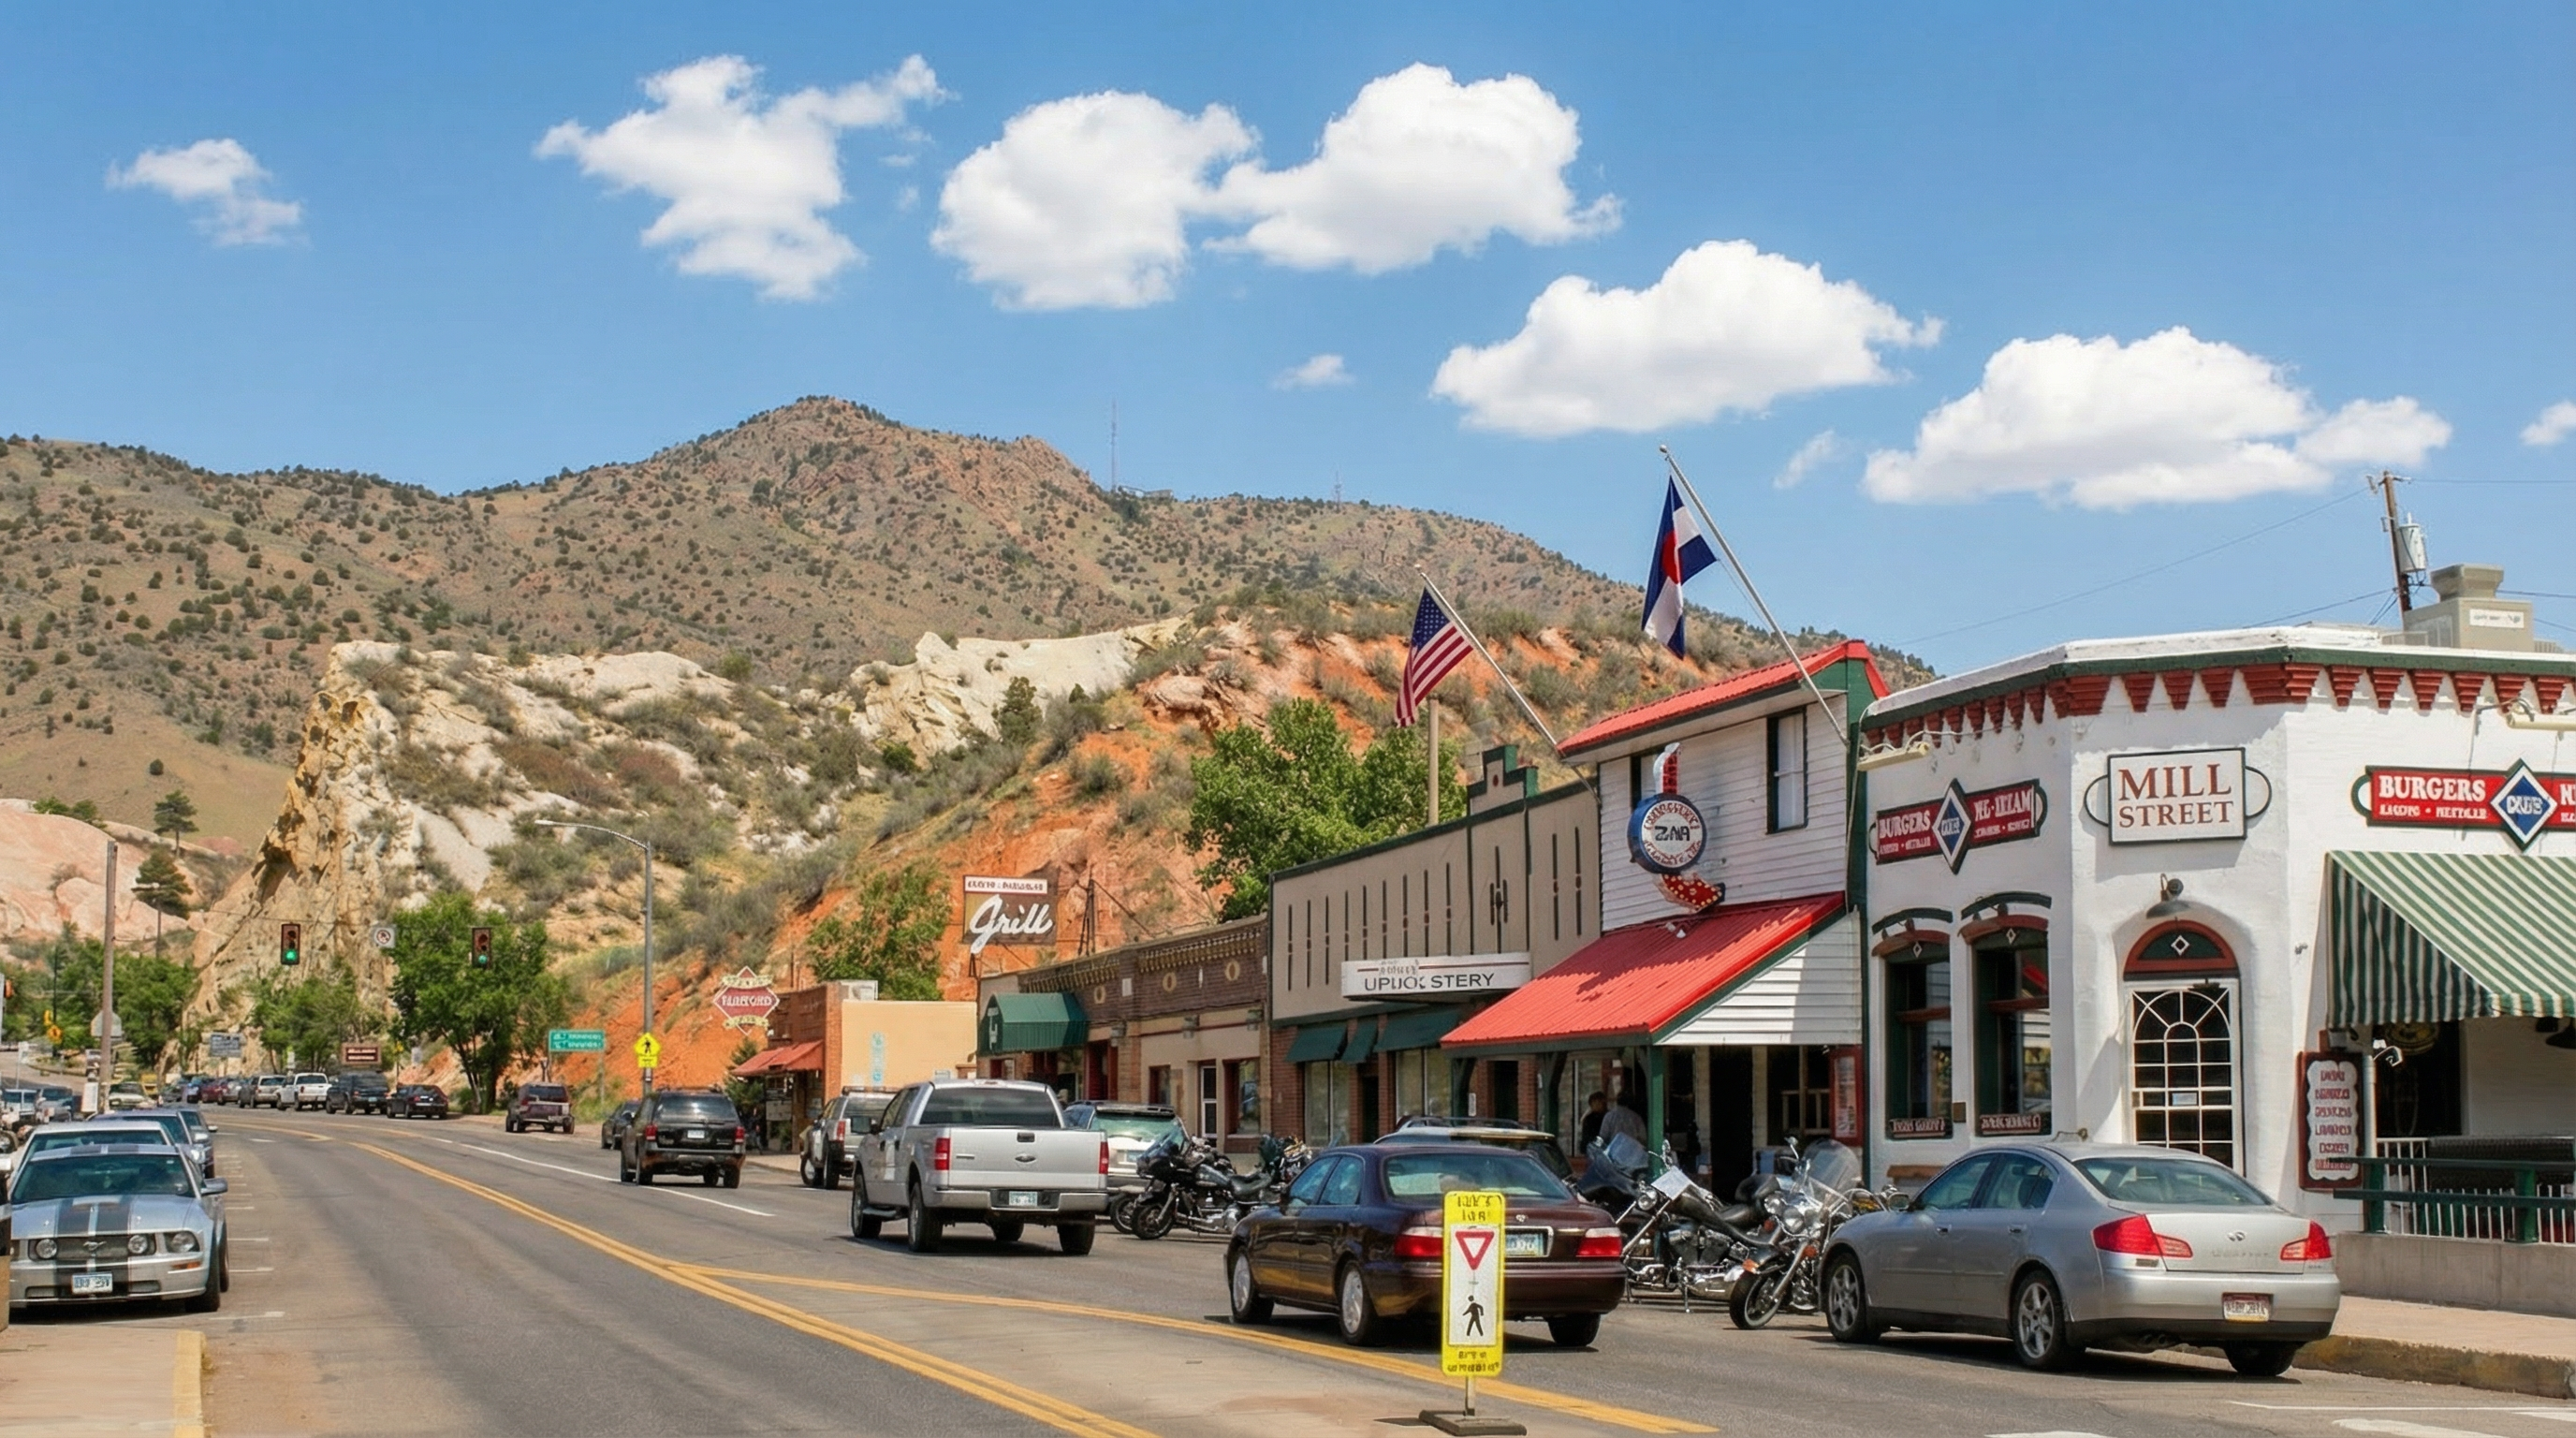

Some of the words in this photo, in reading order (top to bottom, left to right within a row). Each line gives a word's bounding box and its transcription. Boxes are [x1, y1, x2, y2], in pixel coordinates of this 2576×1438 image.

[2118, 763, 2232, 801] MILL
[2378, 774, 2486, 802] BURGERS
[1879, 810, 1931, 839] BURGERS
[2118, 800, 2233, 829] STREET
[969, 893, 1053, 955] Grill
